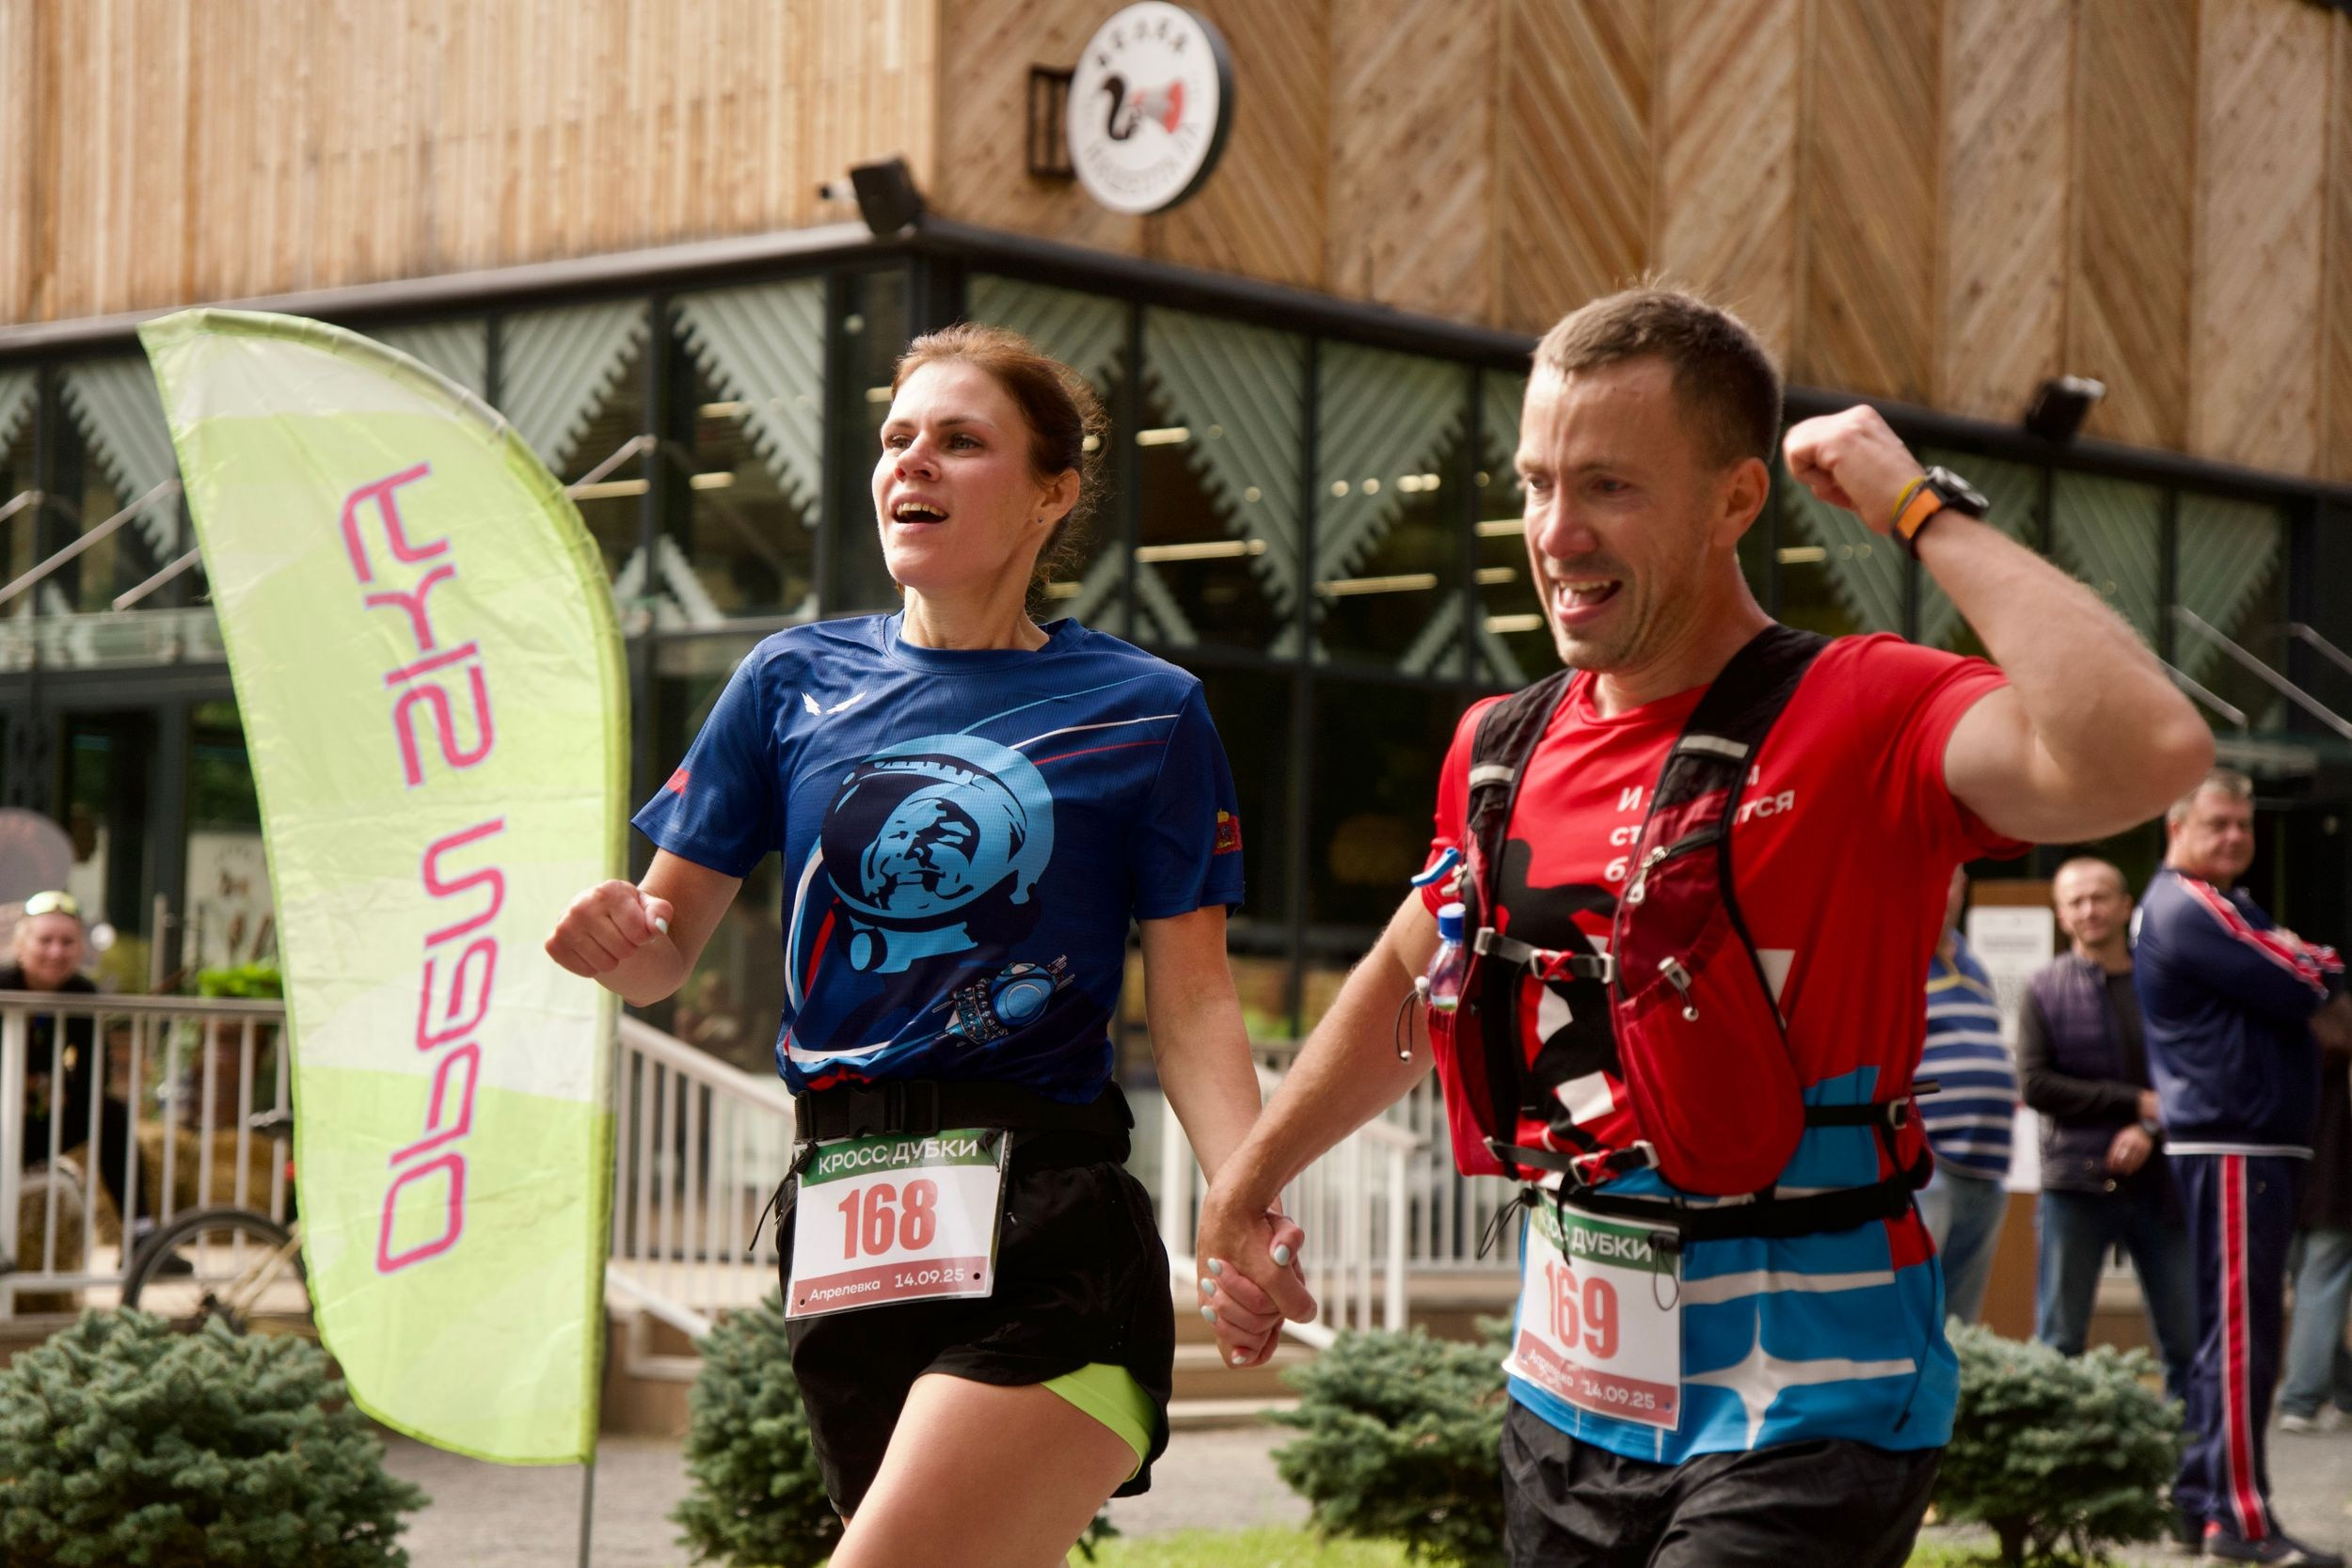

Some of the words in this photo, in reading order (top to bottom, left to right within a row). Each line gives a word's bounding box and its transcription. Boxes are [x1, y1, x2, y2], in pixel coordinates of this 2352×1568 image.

[1616, 785, 1644, 813] И
[818, 1145, 887, 1175] КРОСС
[892, 1139, 977, 1164] ДУБКИ
[837, 1178, 938, 1259] 168
[1571, 1226, 1653, 1263] ДУБКИ
[809, 1278, 881, 1302] Апрелевка
[895, 1267, 964, 1288] 14.09.25
[1545, 1259, 1619, 1360] 169
[1581, 1380, 1656, 1409] 14.09.25
